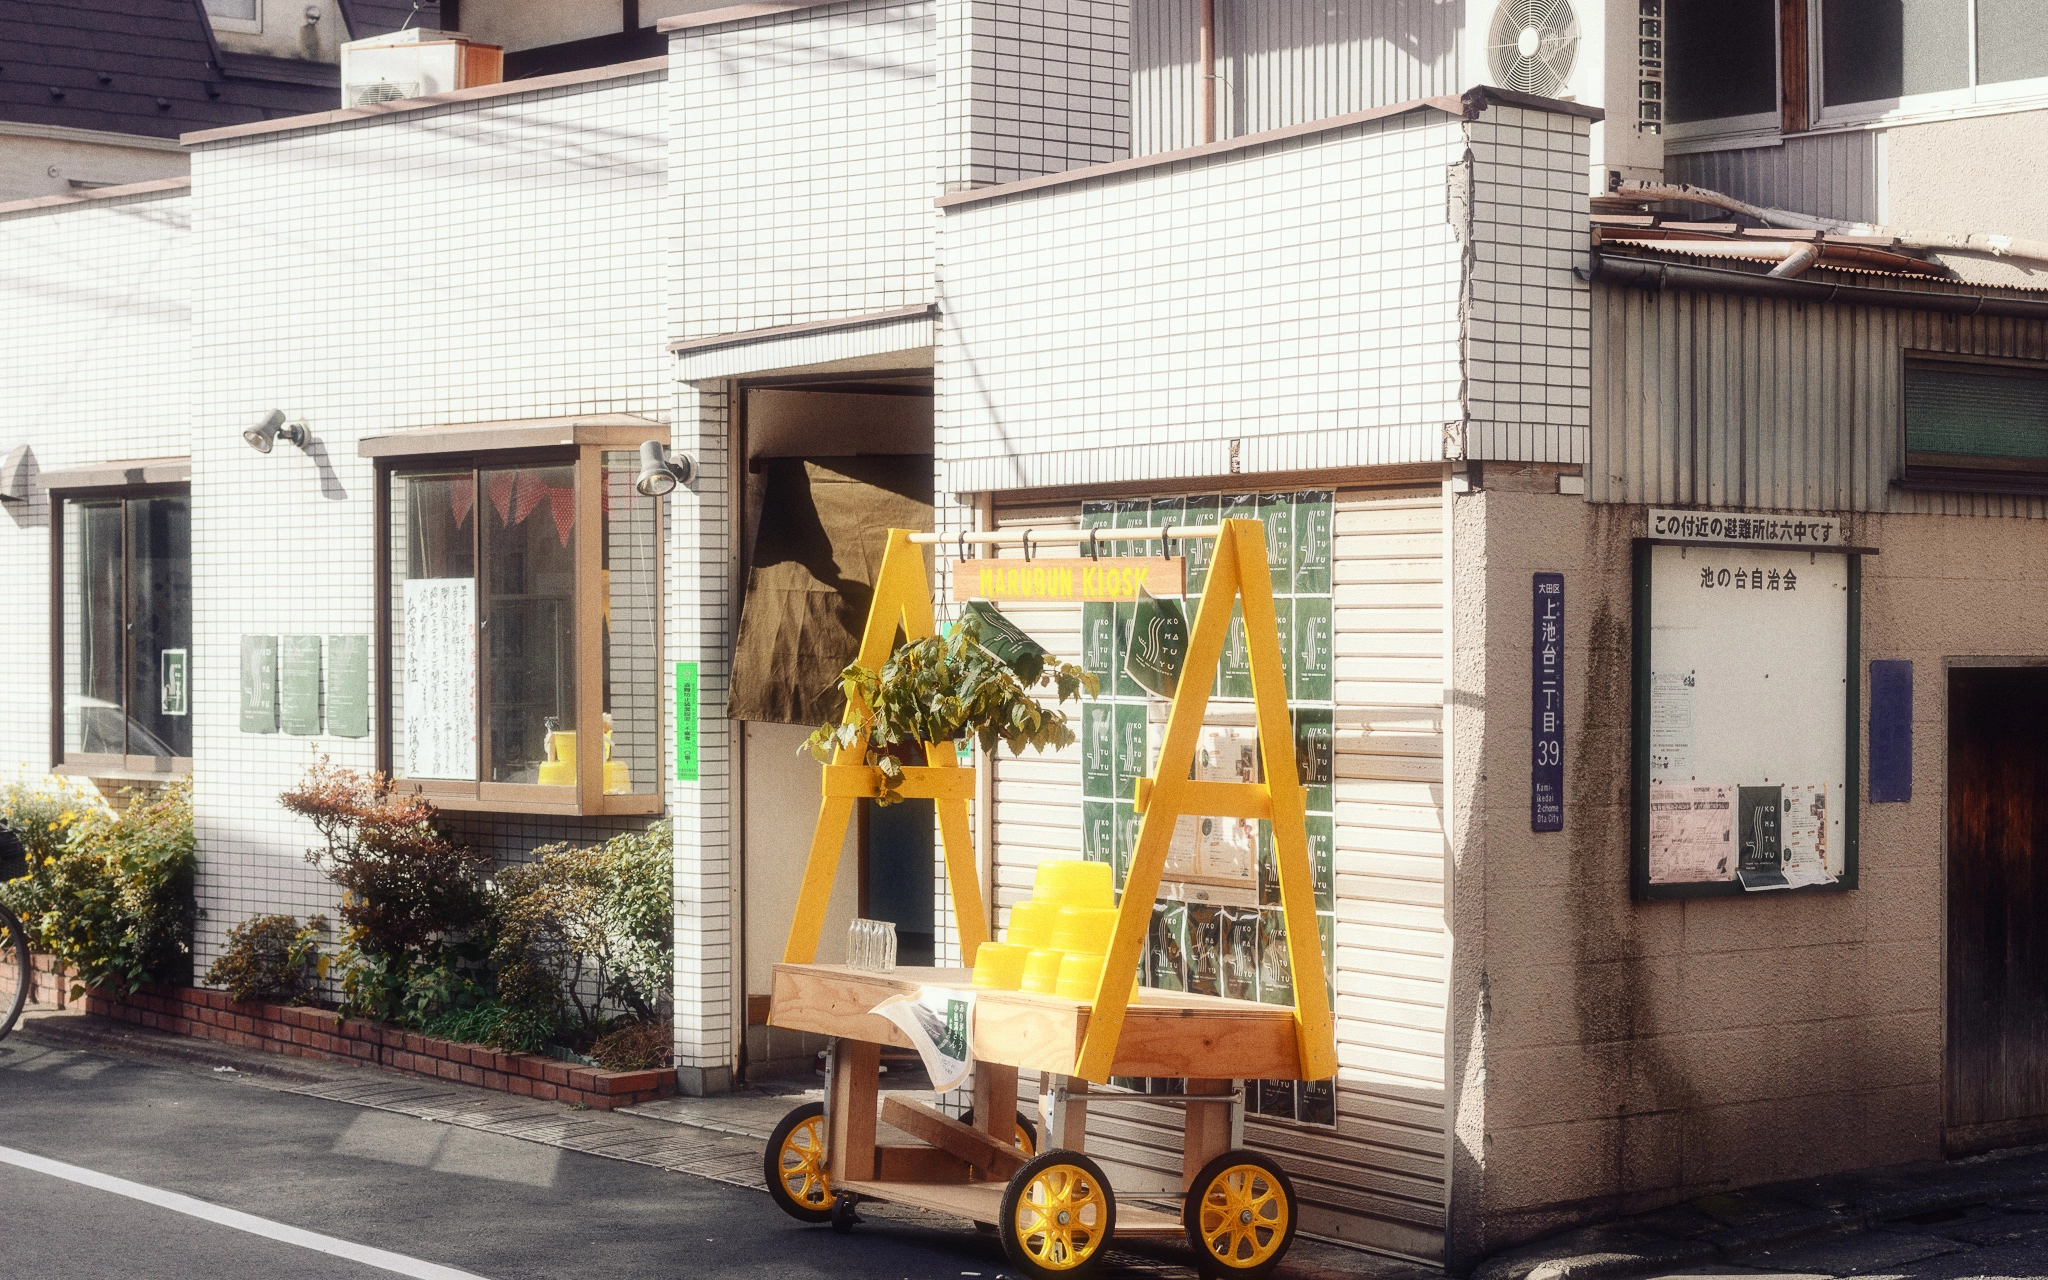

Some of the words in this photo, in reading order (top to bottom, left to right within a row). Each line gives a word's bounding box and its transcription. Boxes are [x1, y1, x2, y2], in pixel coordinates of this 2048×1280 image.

[1655, 515, 1833, 542] この付近の避難所は六中です
[980, 566, 1073, 598] MARUBUN
[1082, 566, 1150, 598] KIOSK
[1700, 566, 1798, 590] 池の台自治会
[1538, 584, 1560, 594] 大田区
[1162, 647, 1177, 655] TU
[1159, 661, 1175, 670] YU
[1542, 598, 1556, 732] 上池台二丁目
[1538, 740, 1560, 766] 39
[1536, 783, 1552, 792] Kami-
[1536, 794, 1554, 802] ikedai
[1537, 804, 1559, 813] 2-chome
[1537, 814, 1546, 823] Ota
[1548, 814, 1559, 824] City
